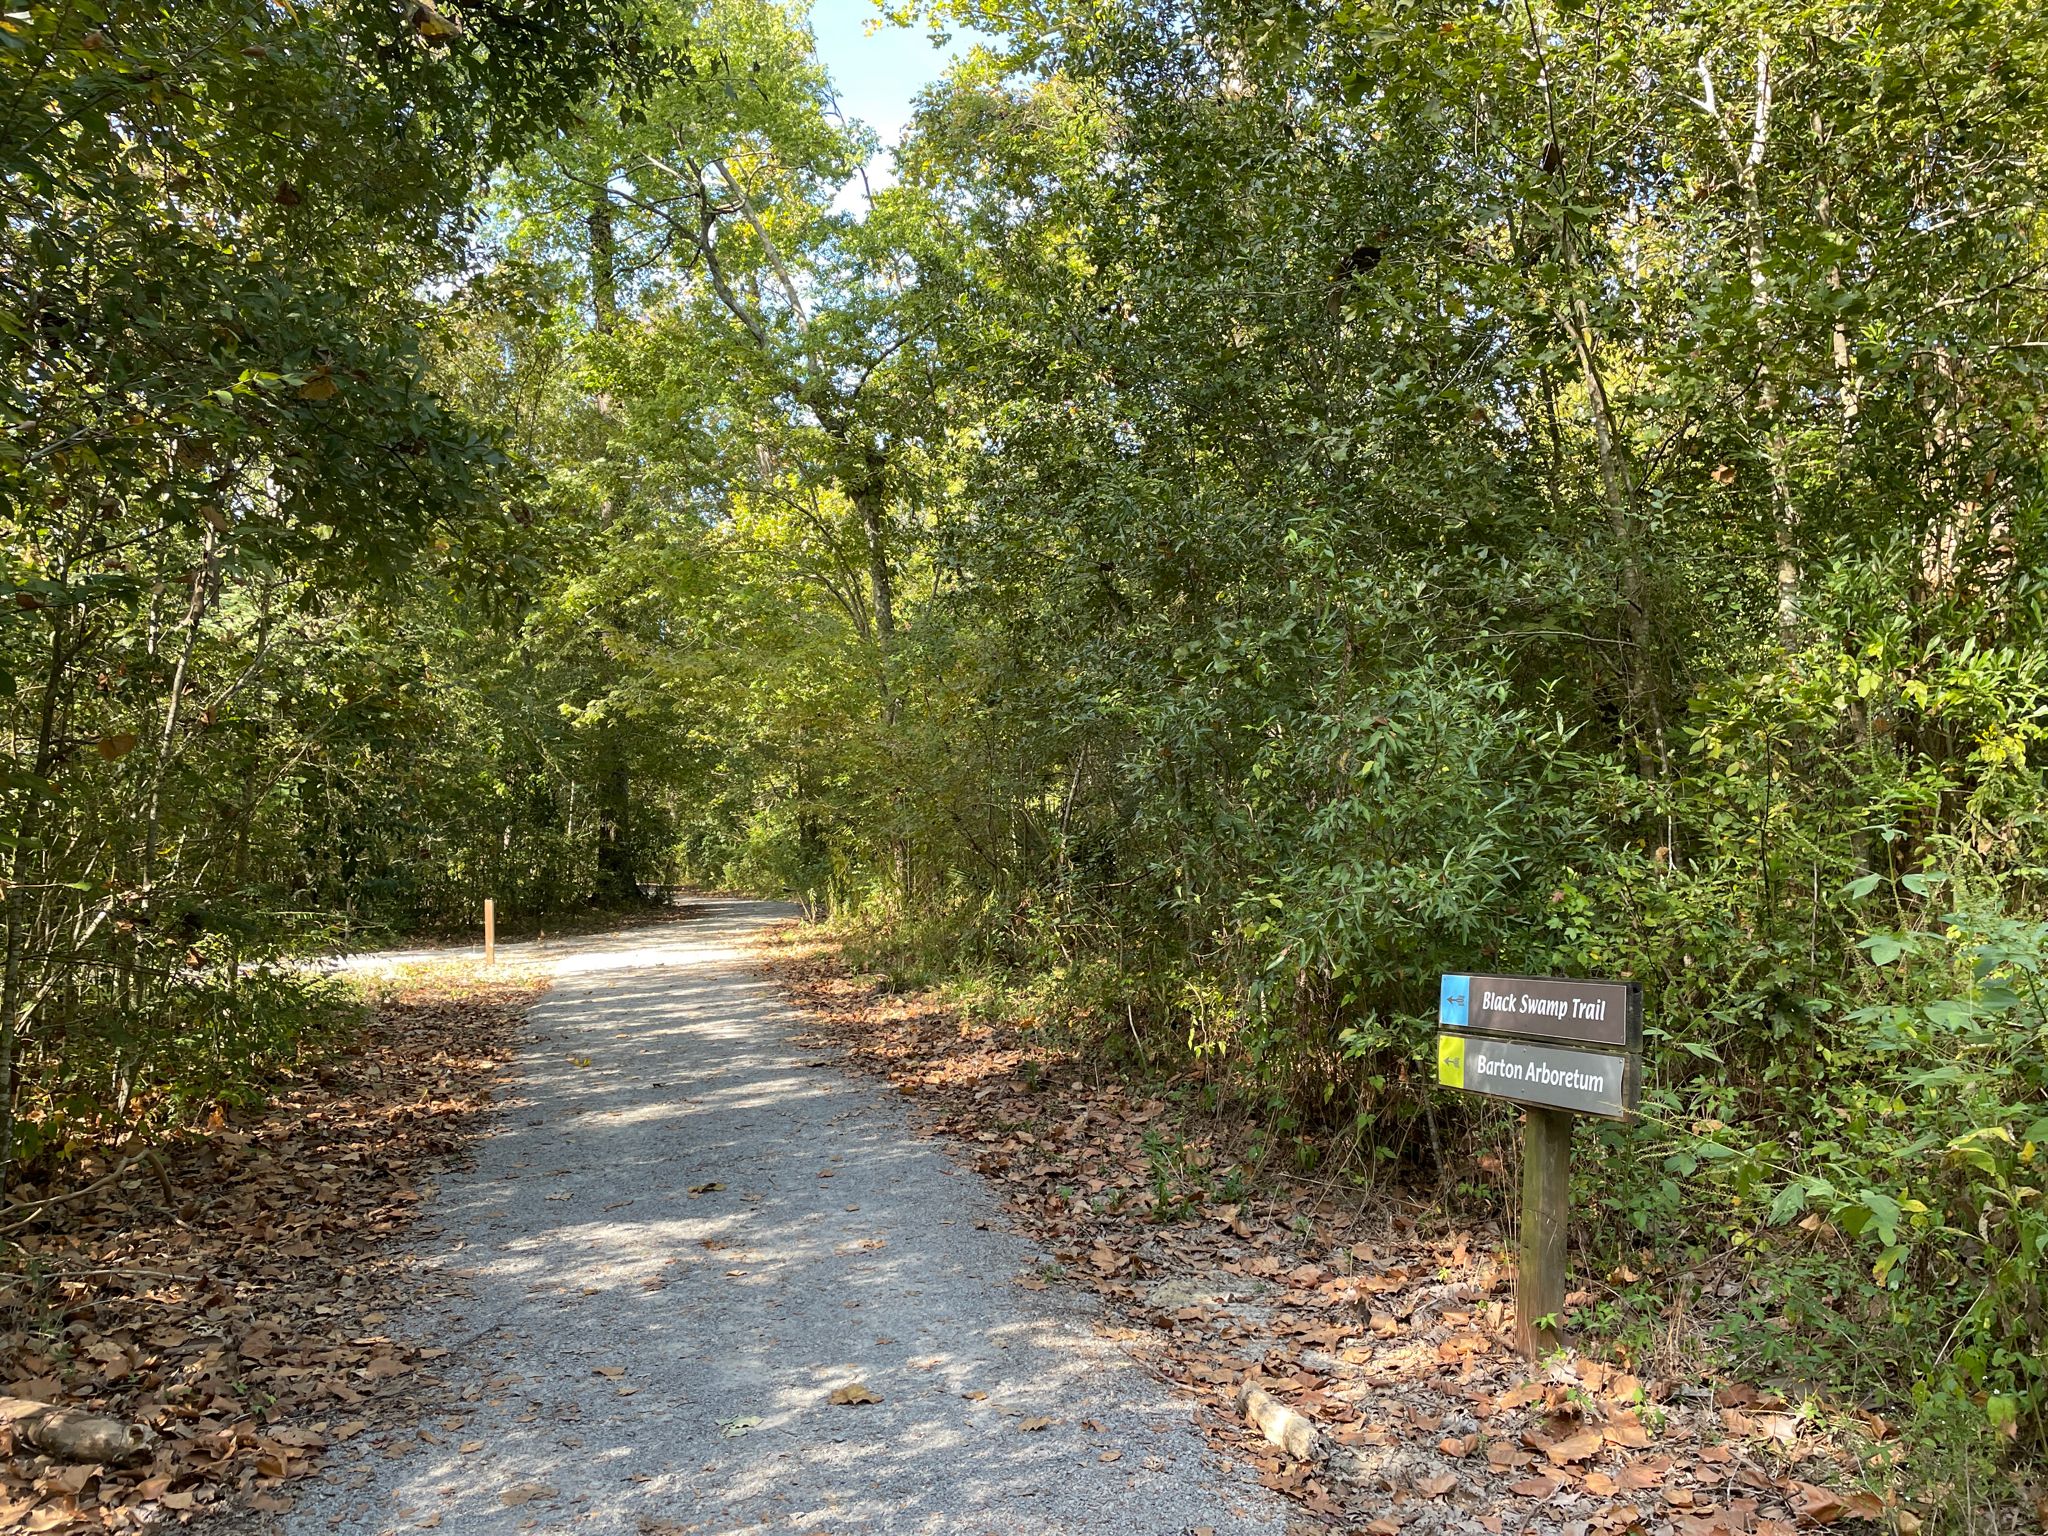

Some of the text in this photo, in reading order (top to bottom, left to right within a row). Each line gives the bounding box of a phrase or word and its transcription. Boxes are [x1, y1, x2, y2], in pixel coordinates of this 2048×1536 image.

[1482, 991, 1606, 1021] Black Swamp Trail
[1477, 1055, 1603, 1093] Barton Arboretum
